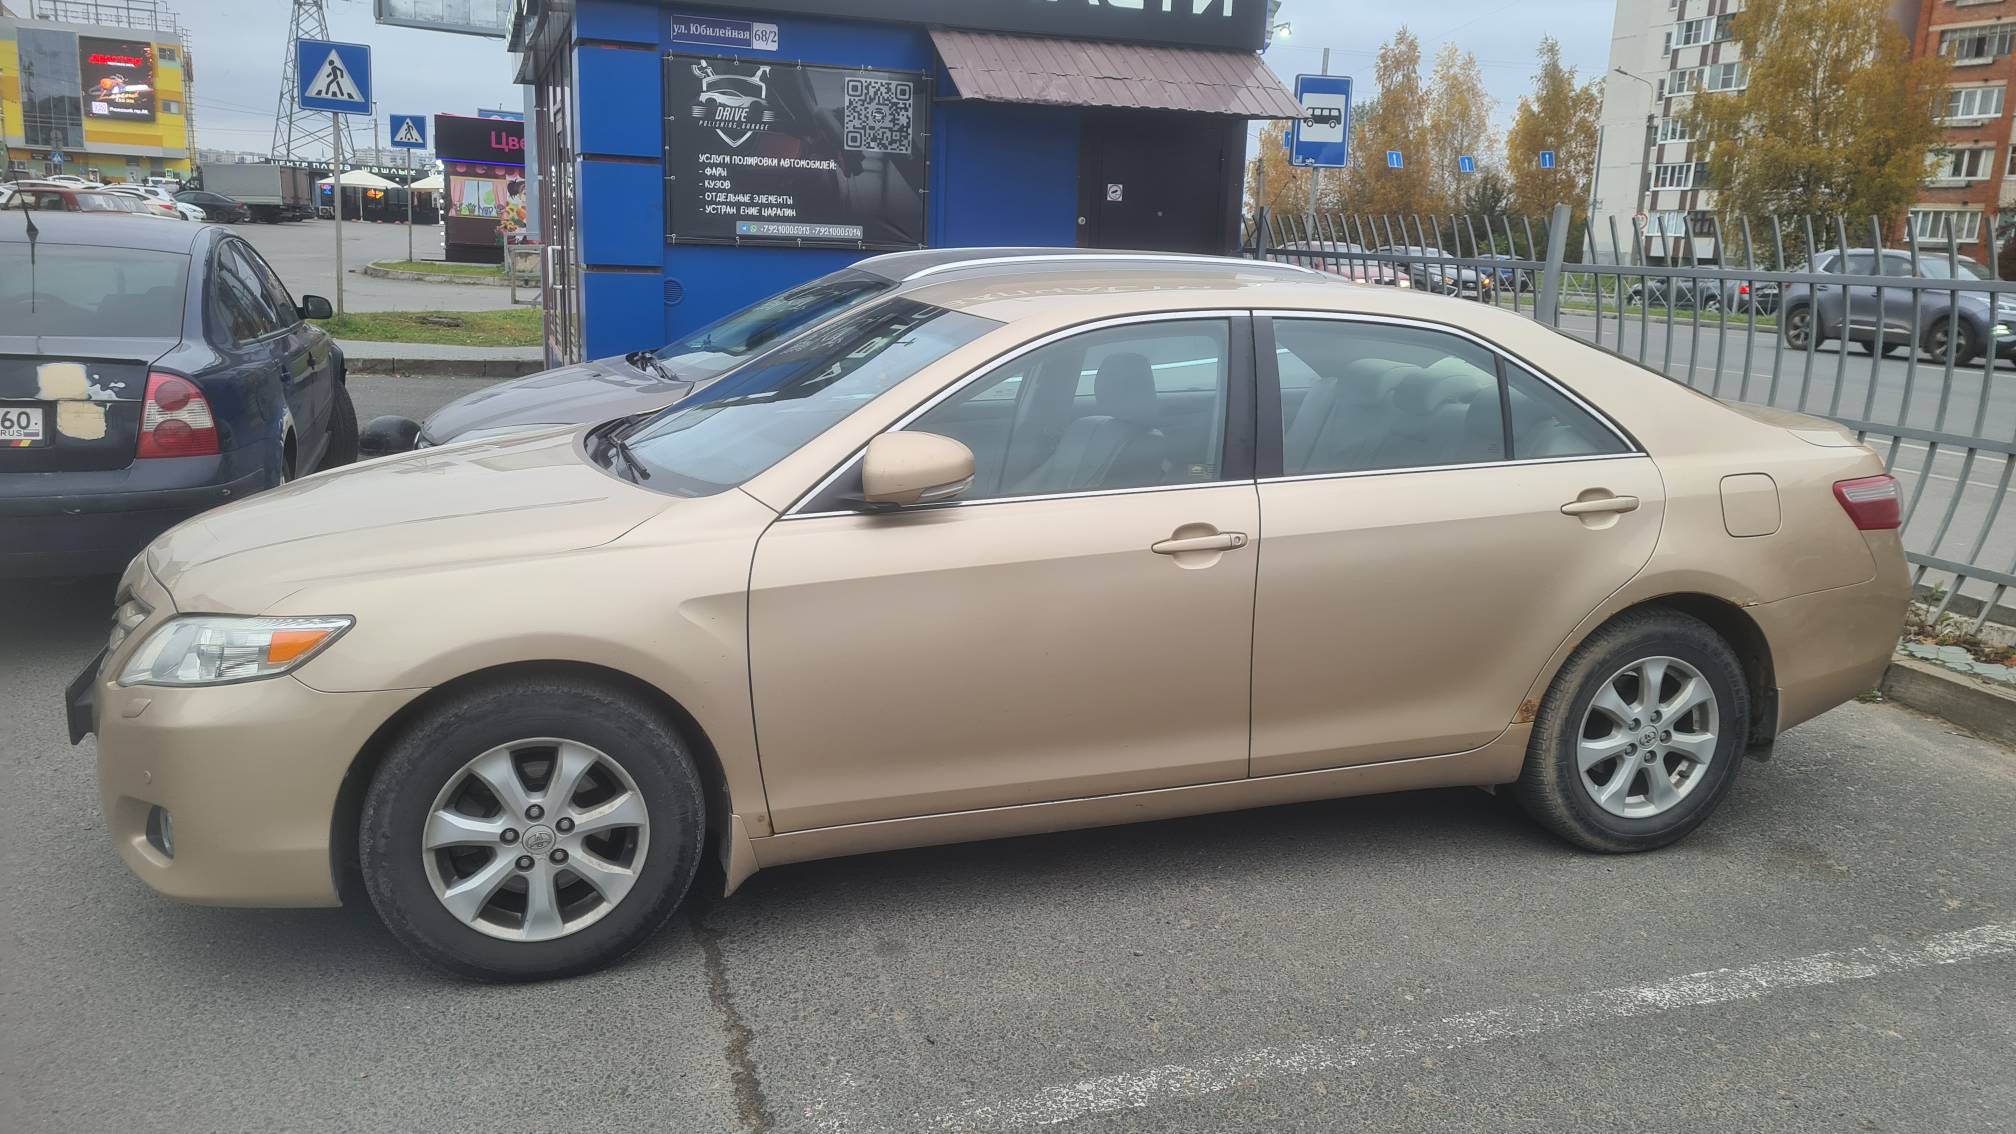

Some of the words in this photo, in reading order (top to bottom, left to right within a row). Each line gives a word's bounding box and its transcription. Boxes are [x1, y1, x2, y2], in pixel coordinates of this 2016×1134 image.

[673, 24, 688, 35] ул.
[690, 23, 750, 39] Юбилейная
[754, 29, 777, 45] 68/2
[716, 107, 749, 121] DRIVE
[698, 153, 730, 164] УСЛУГИ
[732, 156, 778, 167] ПОЛИРОВКИ
[780, 158, 837, 170] АВТОМОБИЛЕЙ:
[704, 167, 727, 177] ФАРЫ
[704, 180, 731, 189] КУЗОВ
[704, 192, 752, 203] ОТДЕЛЬНЫЕ
[753, 194, 793, 204] ЭЛЕМЕНТЫ
[705, 205, 737, 215] УСТРАН
[740, 206, 759, 216] ЕНИЕ
[762, 207, 796, 217] ЦАРАПИН
[0, 411, 31, 430] 60
